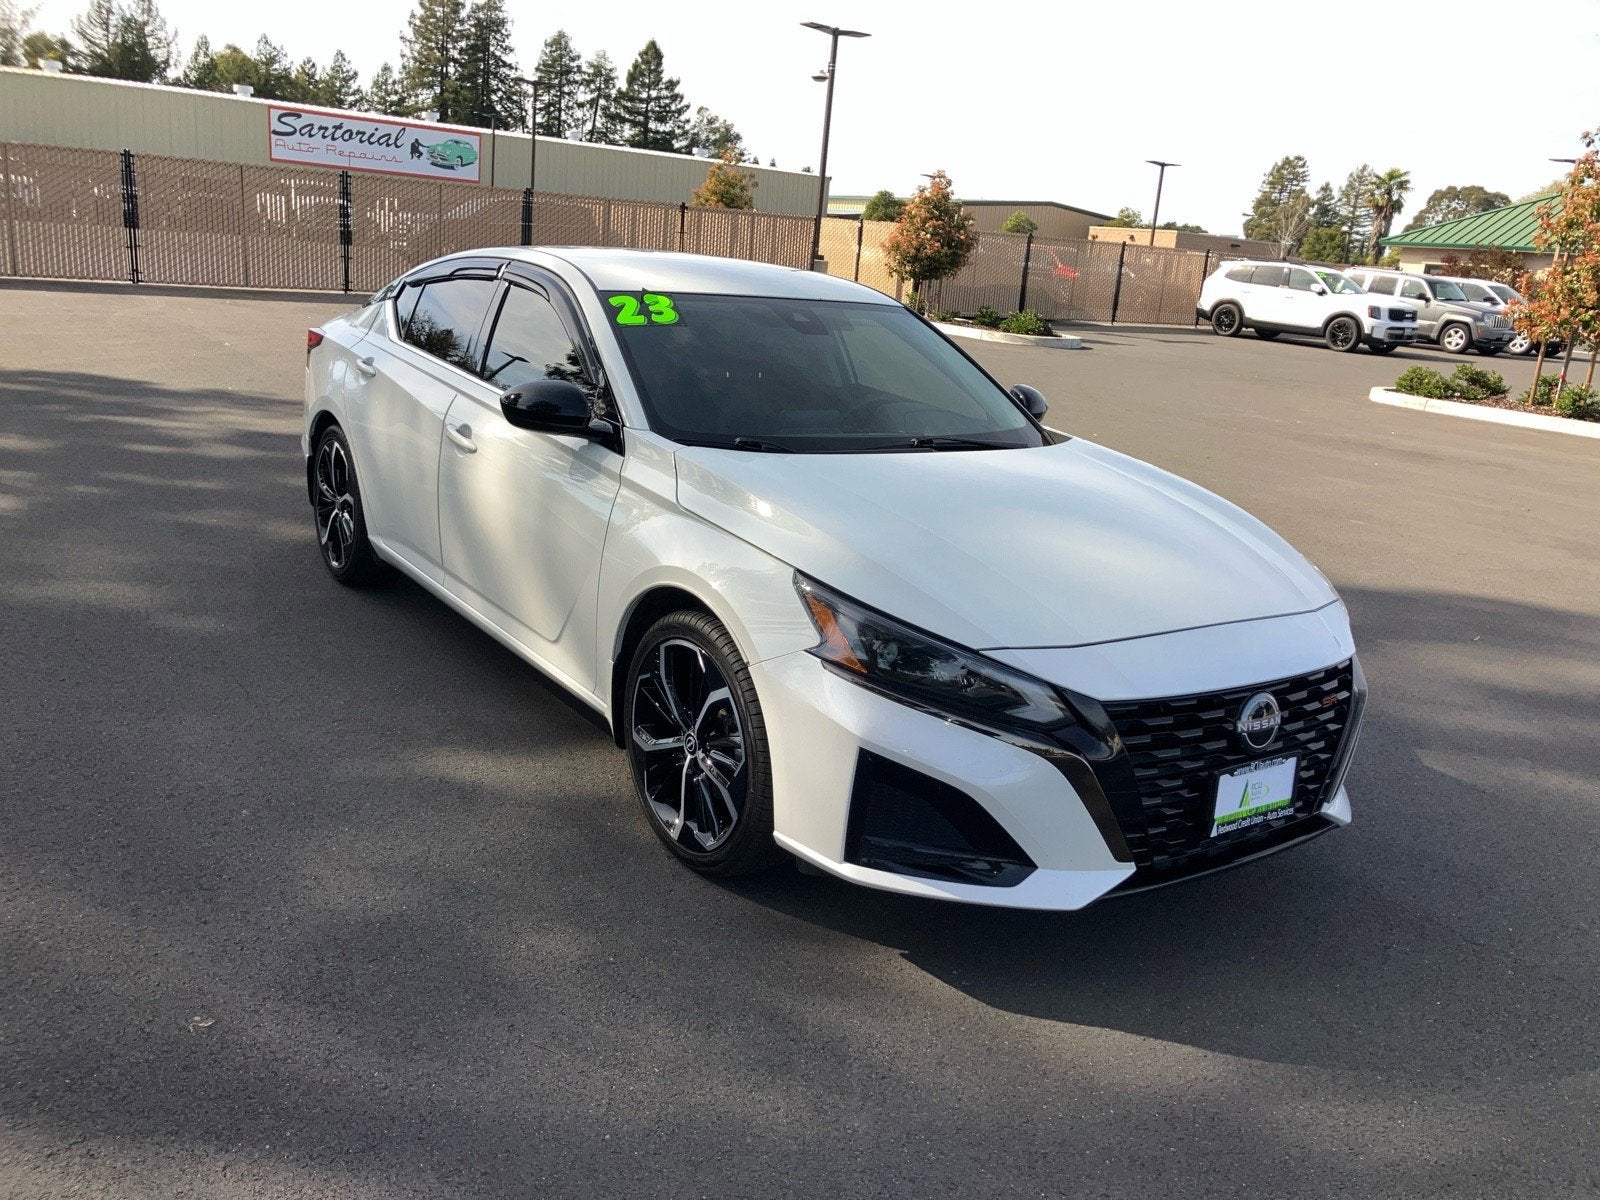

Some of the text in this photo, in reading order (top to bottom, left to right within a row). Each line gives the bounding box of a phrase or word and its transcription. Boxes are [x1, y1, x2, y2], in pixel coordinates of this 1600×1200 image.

[271, 112, 405, 149] Sartorial
[274, 138, 403, 168] Auto Repairs
[608, 294, 679, 325] 23
[1238, 716, 1281, 732] NISSAN
[1217, 822, 1238, 834] Redwood
[1237, 818, 1251, 829] Credit
[1250, 814, 1264, 825] Union
[1266, 811, 1278, 821] Auto
[1277, 807, 1295, 818] Services
